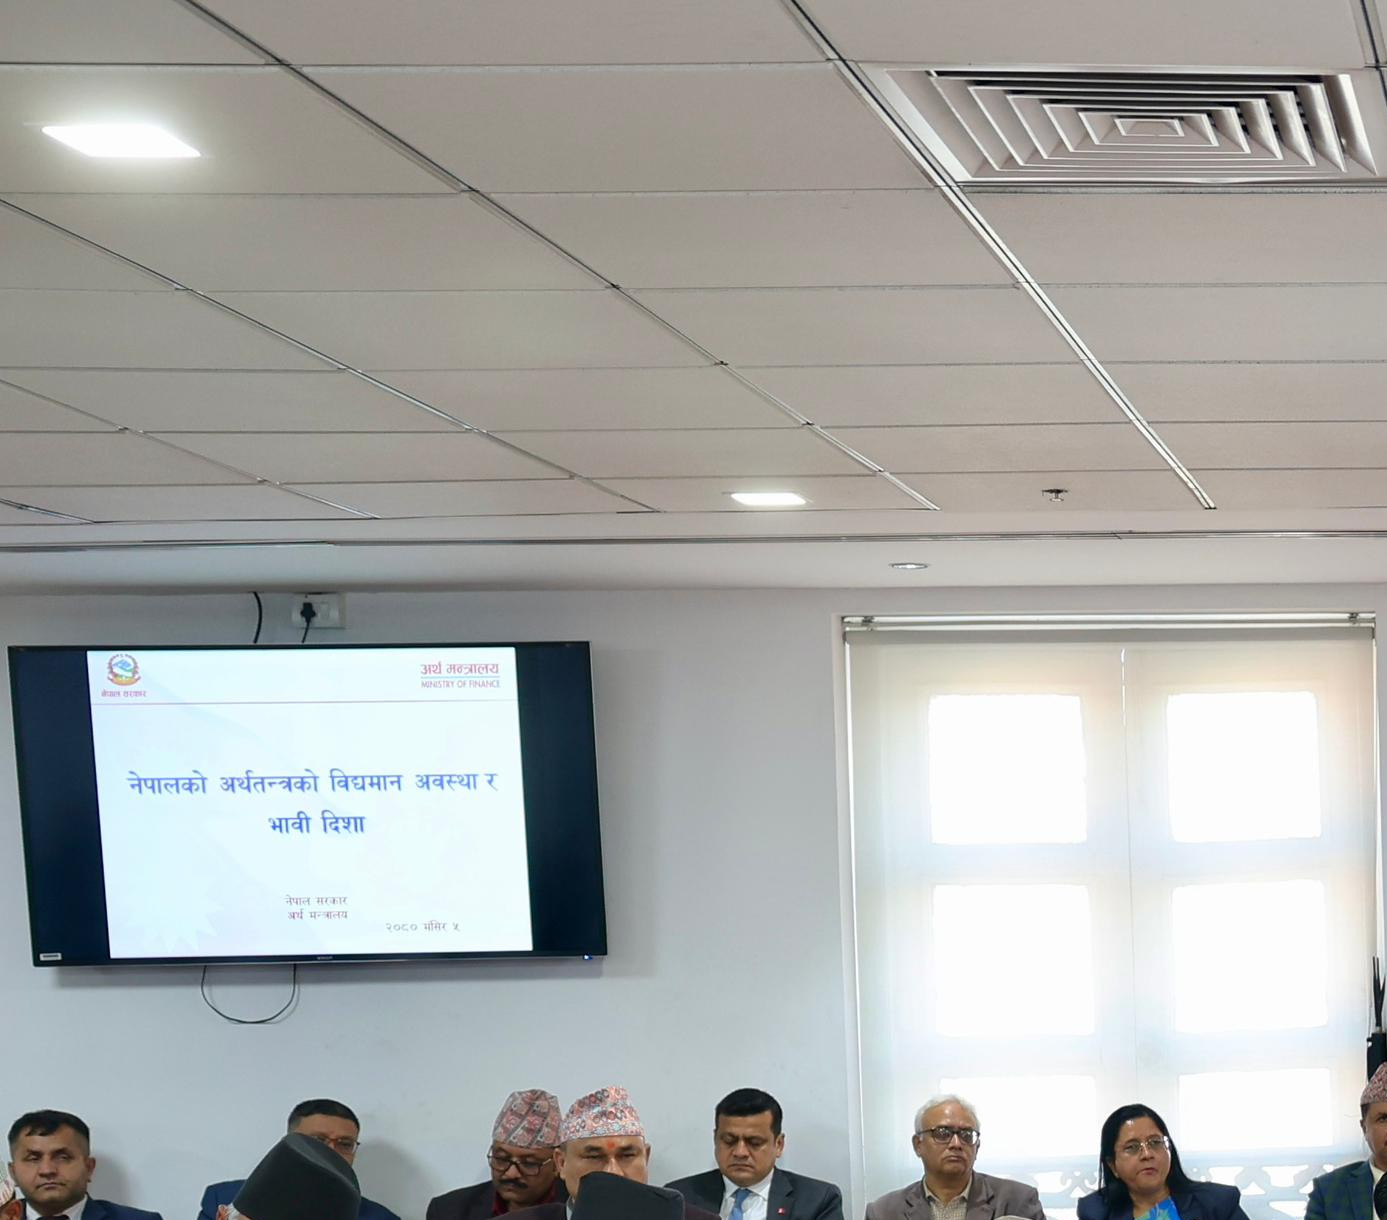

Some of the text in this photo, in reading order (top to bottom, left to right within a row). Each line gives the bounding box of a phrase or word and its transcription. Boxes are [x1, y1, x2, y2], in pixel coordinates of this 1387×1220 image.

[420, 661, 500, 676] अर्थ मन्त्रालय
[421, 678, 501, 689] MINISTRY OF FINANCE
[126, 768, 499, 796] नेपालको अर्थतन्त्रको विद्यमान अवस्था र
[268, 810, 365, 834] भावी दिशा
[285, 894, 347, 907] नेपाल सरकार
[287, 909, 348, 921] अर्थ मन्त्रालय
[386, 922, 418, 933] २०८०
